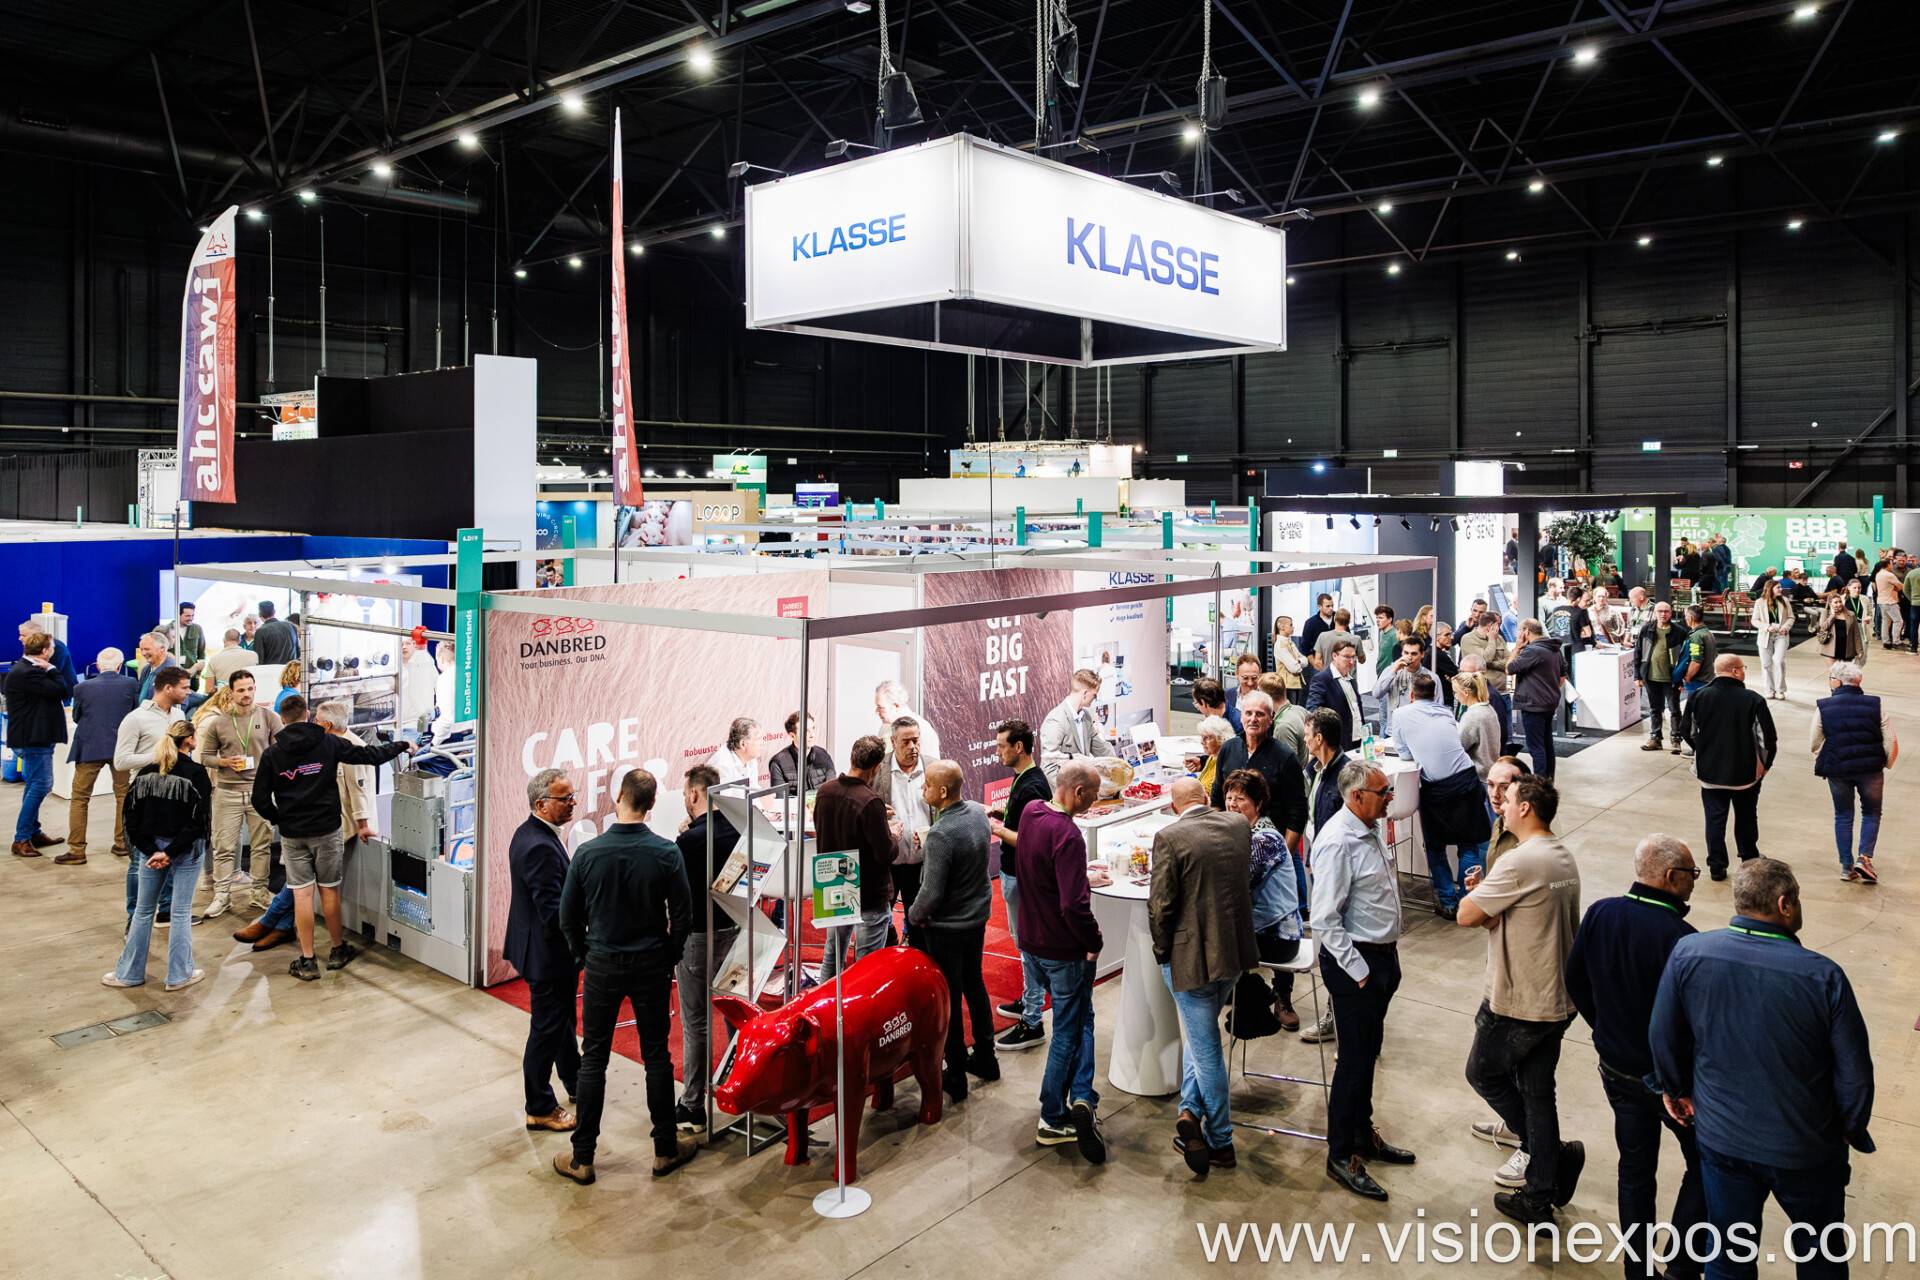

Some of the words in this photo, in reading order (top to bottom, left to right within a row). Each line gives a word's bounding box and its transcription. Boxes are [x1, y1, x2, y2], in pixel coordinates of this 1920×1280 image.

[792, 213, 907, 262] KLASSE
[1066, 216, 1221, 296] KLASSE
[189, 402, 220, 493] ahc
[1671, 517, 1700, 527] LKE
[1671, 528, 1709, 539] EGIO
[1786, 518, 1847, 537] BBB
[1790, 540, 1838, 550] LEVER
[464, 609, 474, 669] Netherlands
[519, 635, 606, 658] DANBRED
[986, 633, 1023, 665] BIG
[519, 662, 538, 671] Your
[576, 656, 588, 664] Our
[463, 672, 472, 715] DanBred
[979, 666, 1029, 702] FAST
[521, 717, 640, 778] CARE
[879, 1021, 912, 1048] DANBRED
